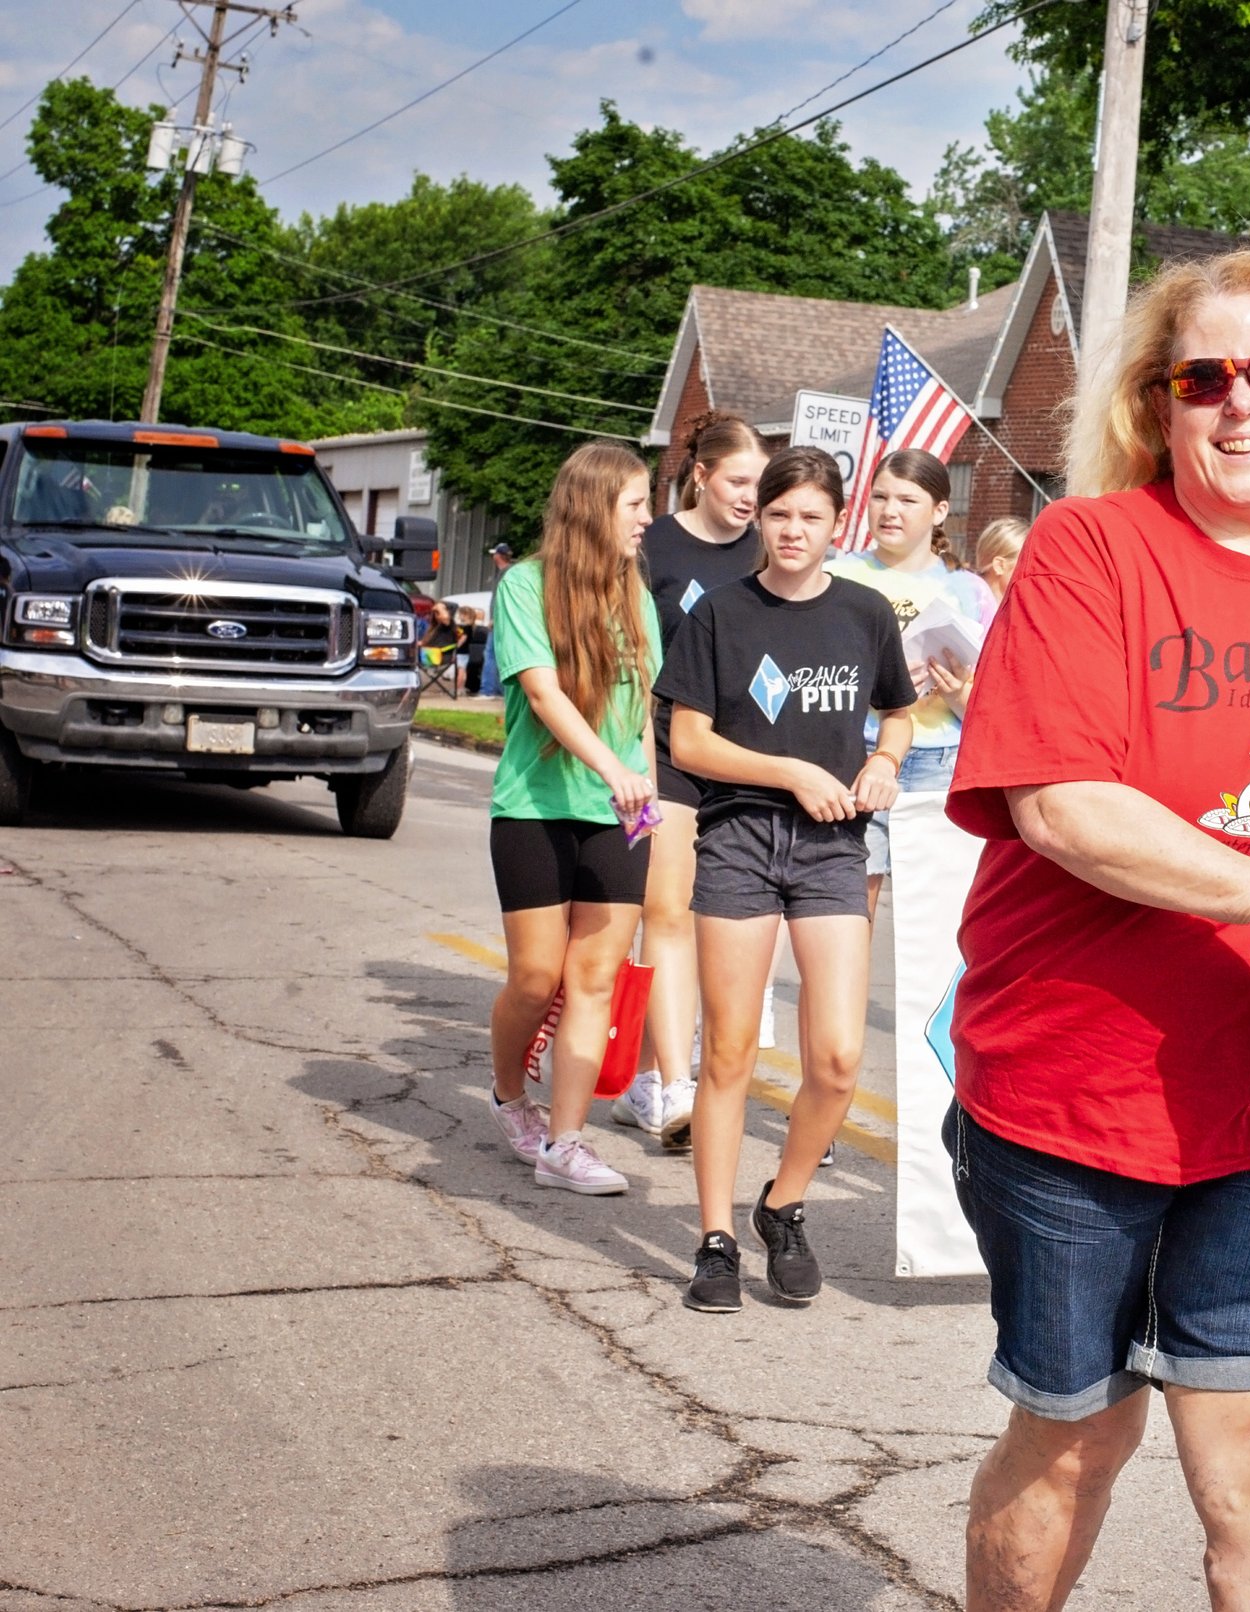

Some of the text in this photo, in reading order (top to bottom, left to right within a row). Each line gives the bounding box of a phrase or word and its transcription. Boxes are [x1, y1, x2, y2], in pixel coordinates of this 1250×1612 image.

[805, 405, 862, 426] SPEED
[809, 426, 852, 444] LIMIT
[790, 665, 860, 692] DANCE
[802, 685, 859, 713] PITT
